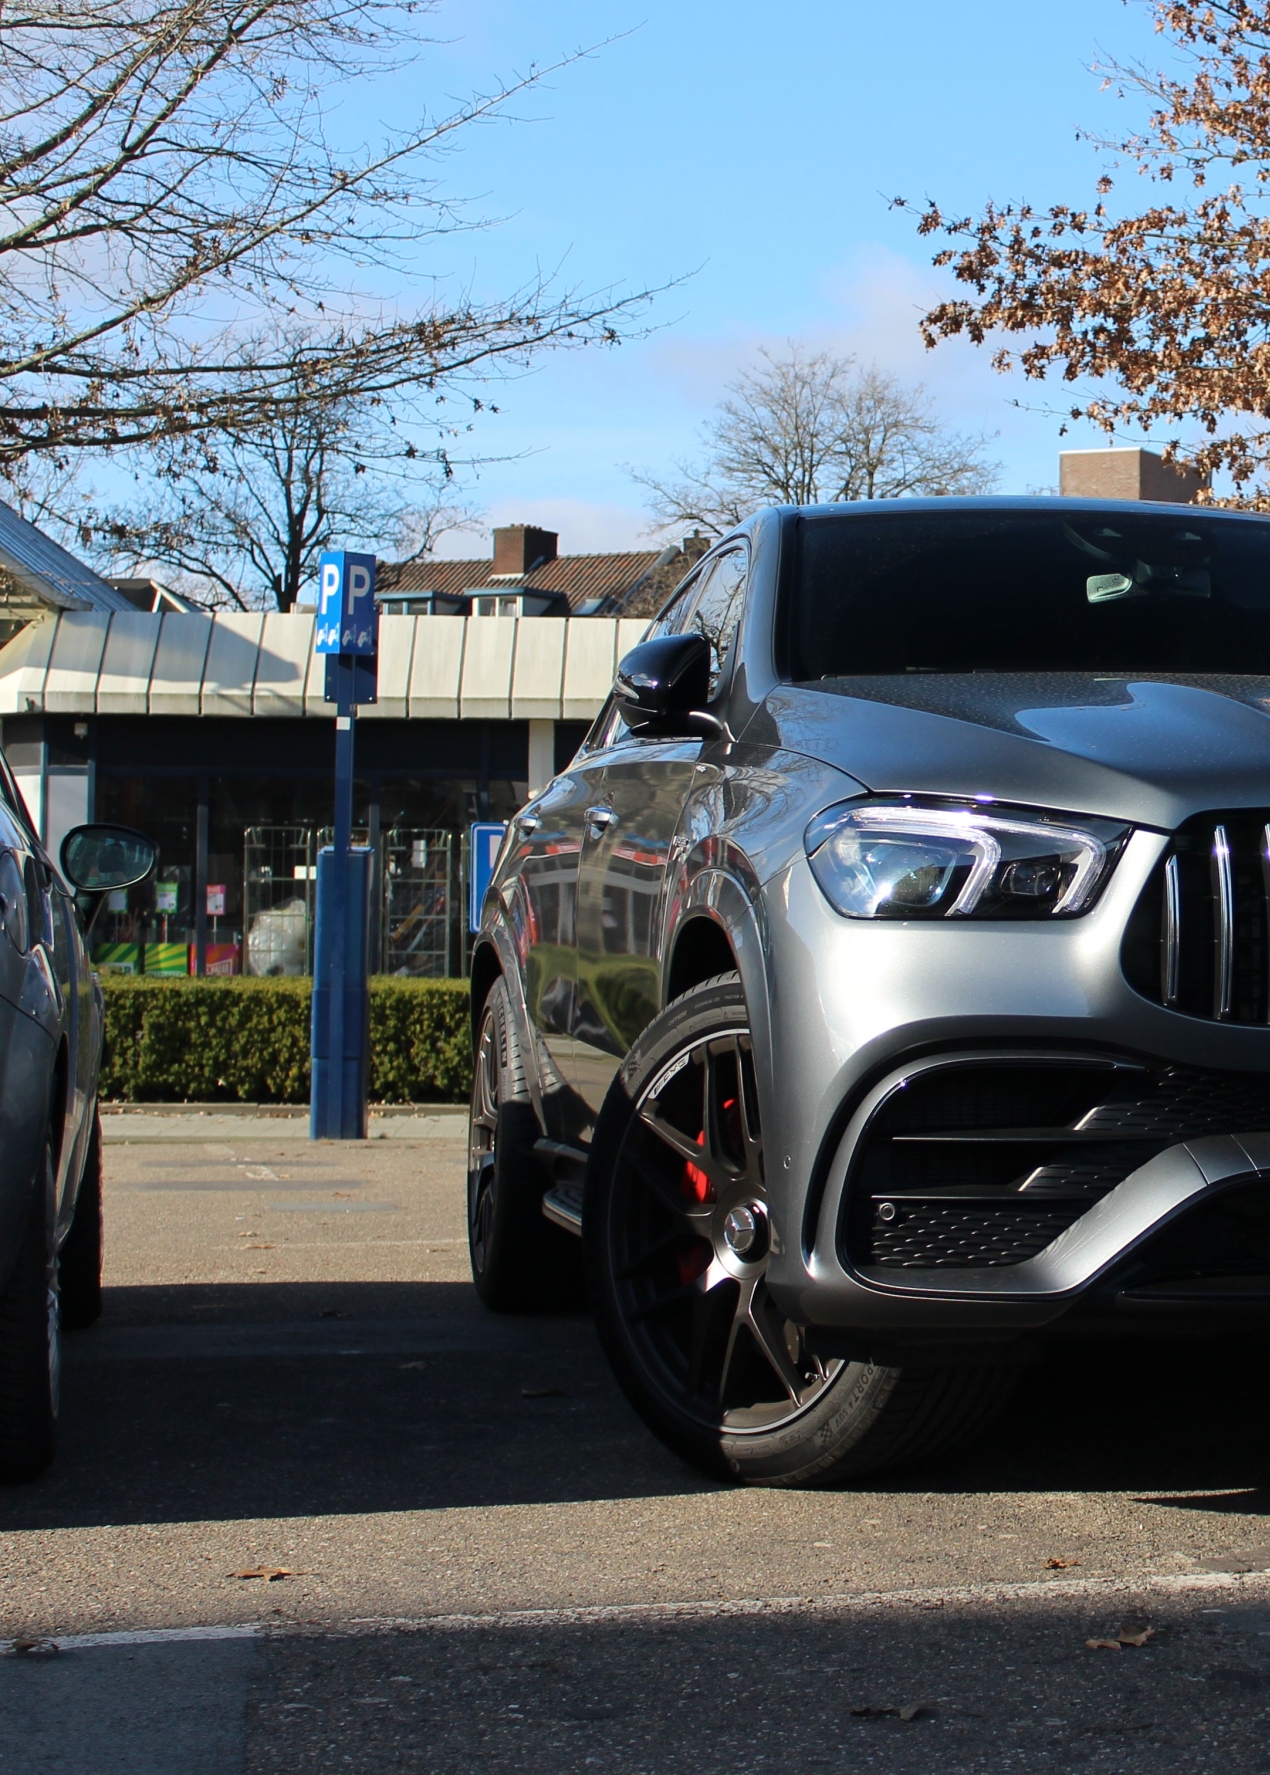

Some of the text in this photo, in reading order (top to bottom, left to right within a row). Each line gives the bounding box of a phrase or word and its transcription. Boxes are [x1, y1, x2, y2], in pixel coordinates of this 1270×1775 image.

[320, 563, 340, 615] P
[347, 564, 371, 615] P
[855, 1362, 875, 1403] PORT
[835, 1408, 849, 1427] SUV
